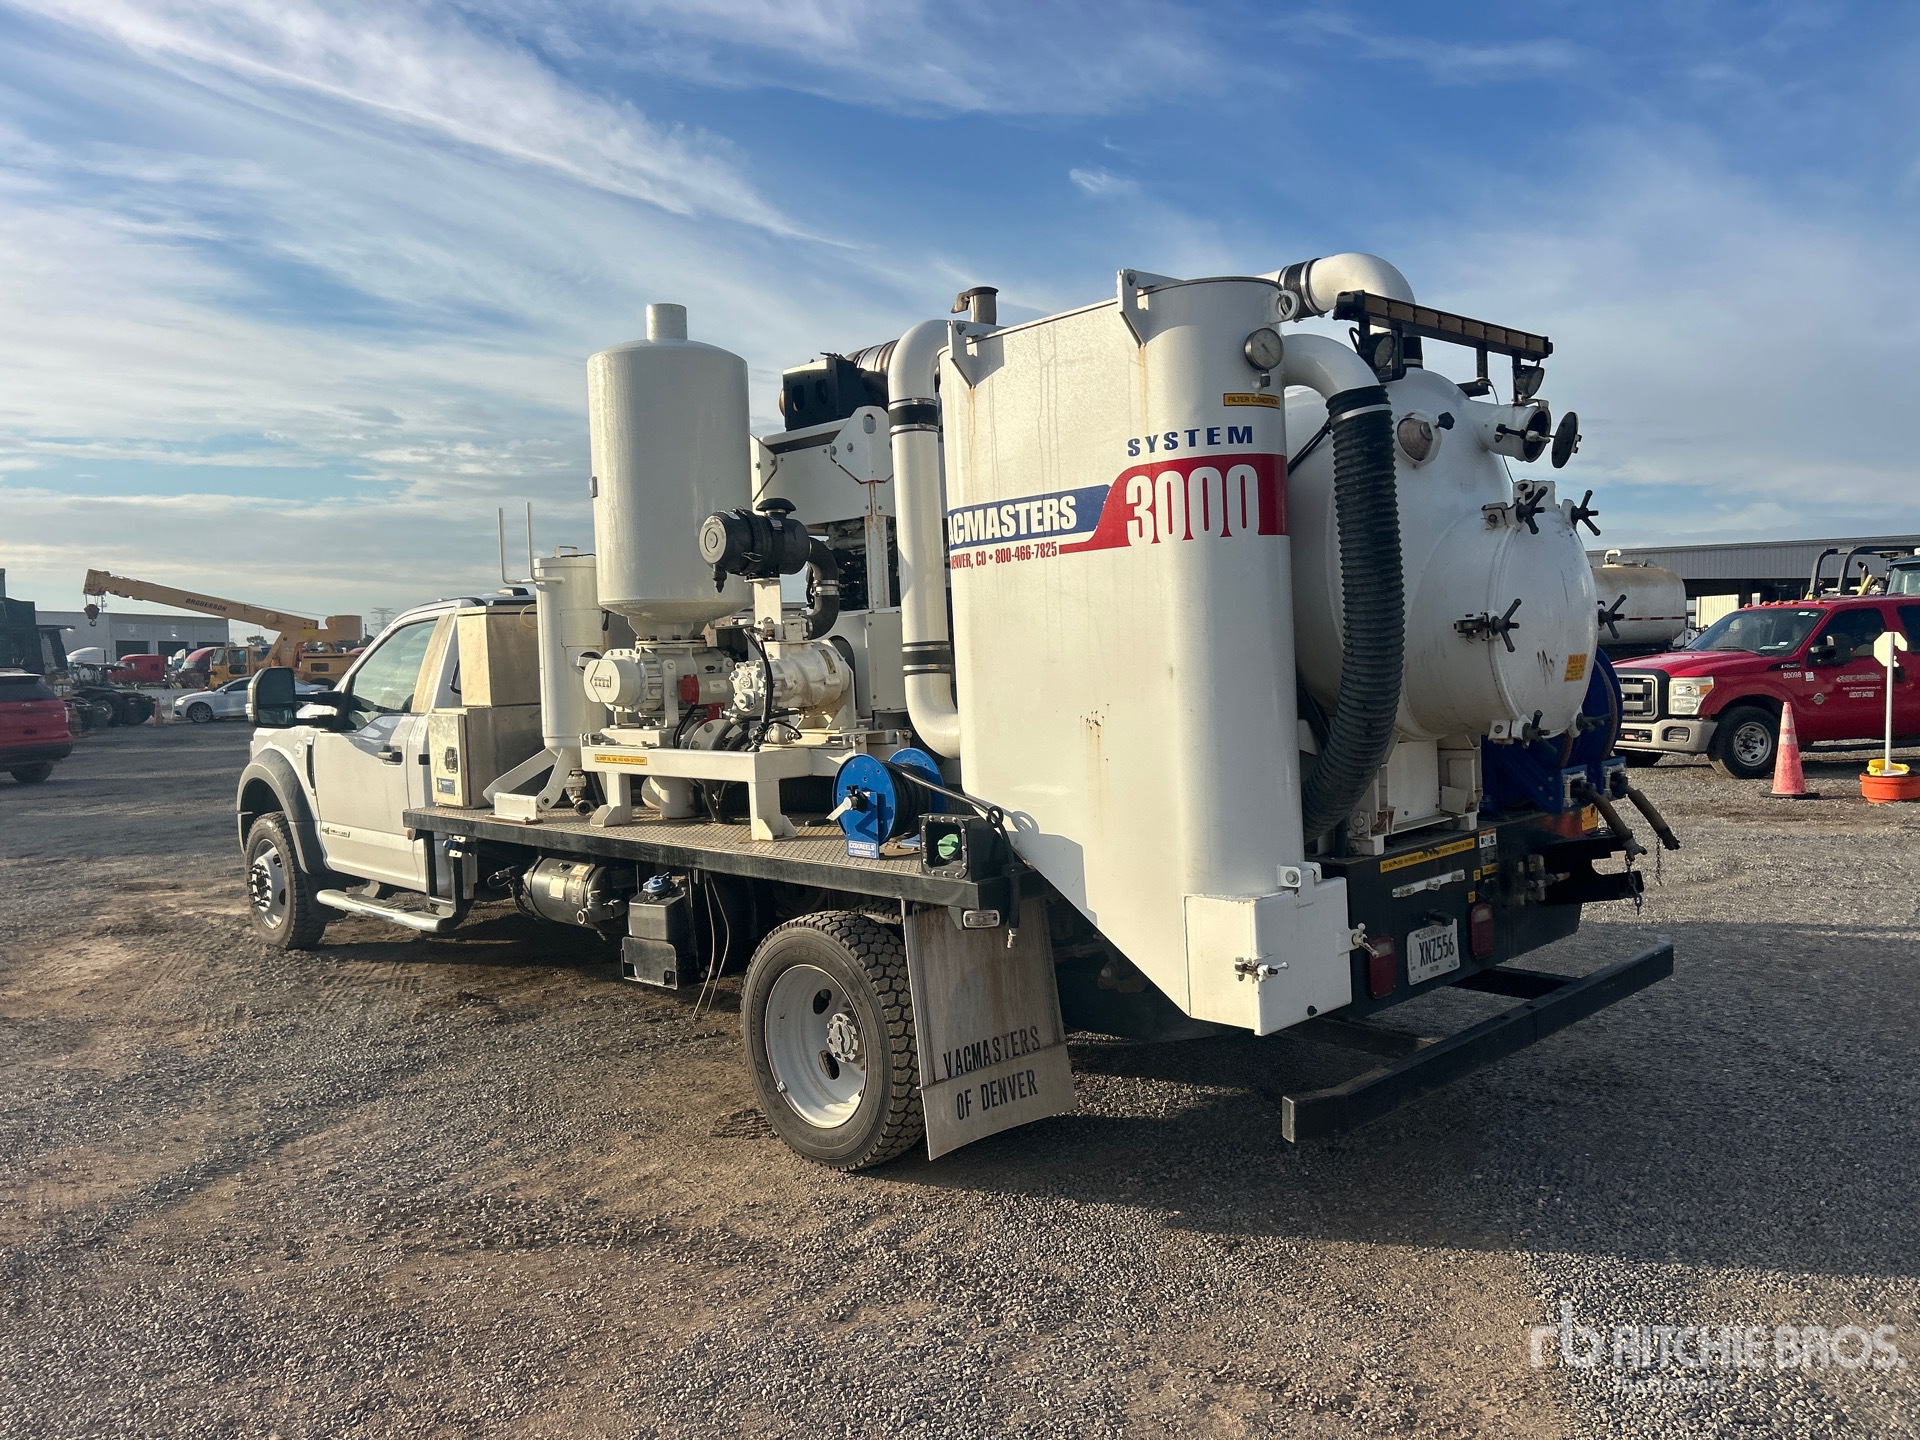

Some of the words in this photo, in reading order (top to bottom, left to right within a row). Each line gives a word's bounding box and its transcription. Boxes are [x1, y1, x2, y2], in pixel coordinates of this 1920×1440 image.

[1127, 425, 1253, 457] SYSTEM
[947, 495, 1077, 546] ACMASTERS
[1125, 463, 1260, 546] 3000
[975, 550, 987, 567] CO
[995, 541, 1057, 564] 800-466-7825
[1418, 932, 1455, 967] XNZ556
[943, 1025, 1040, 1078] VACMASTERS
[956, 1088, 971, 1120] OF
[980, 1069, 1038, 1111] DENVER
